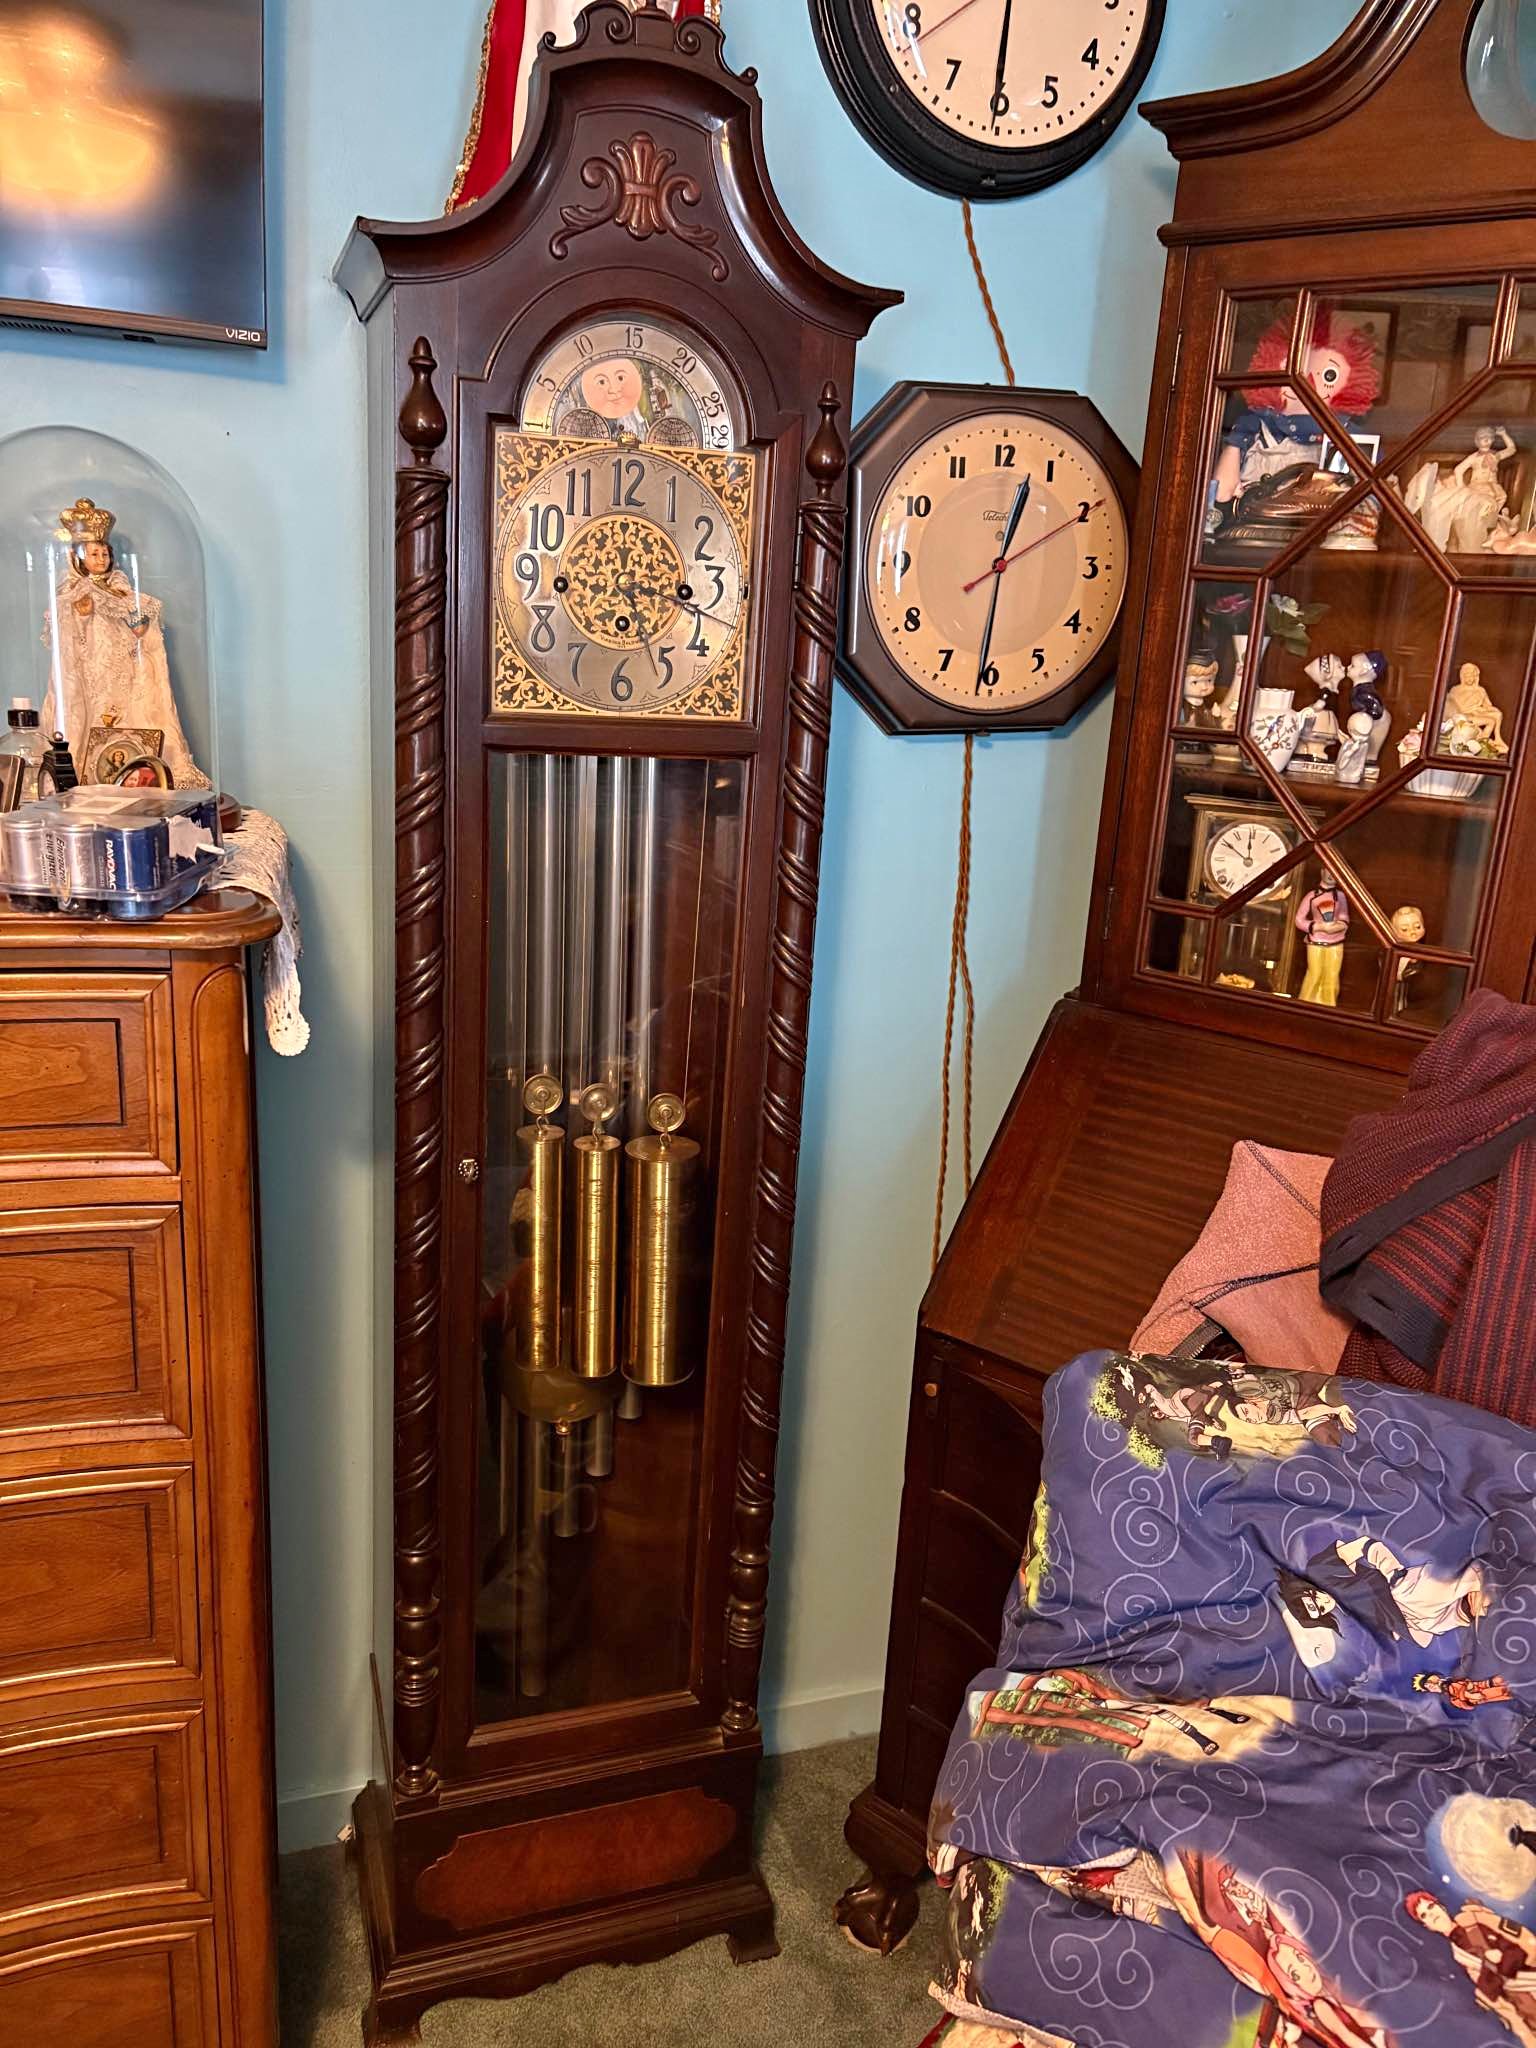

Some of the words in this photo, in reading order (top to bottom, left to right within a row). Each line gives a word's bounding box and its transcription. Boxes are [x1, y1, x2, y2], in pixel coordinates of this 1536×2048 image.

[904, 3, 921, 38] 8
[1081, 38, 1100, 70] 4
[946, 59, 962, 90] 7
[990, 82, 1010, 117] 6
[1041, 76, 1058, 108] 5
[225, 328, 261, 342] VIZIO
[573, 334, 594, 357] 10
[625, 326, 644, 349] 15
[671, 346, 697, 375] 20
[536, 373, 556, 393] 5
[702, 391, 725, 418] 25
[524, 421, 544, 429] 1
[710, 424, 729, 449] 29
[994, 444, 1016, 467] 12
[611, 458, 646, 507] 12
[1046, 460, 1055, 482] 1
[565, 468, 592, 517] 11
[666, 476, 676, 523] 1
[905, 495, 931, 517] 10
[528, 503, 565, 551] 10
[1078, 502, 1091, 523] 2
[694, 515, 715, 561] 2
[515, 552, 540, 601] 9
[893, 550, 911, 577] 9
[1082, 556, 1099, 579] 3
[704, 564, 726, 611] 3
[530, 604, 556, 653] 8
[686, 610, 710, 657] 4
[904, 607, 921, 632] 8
[1063, 609, 1082, 634] 4
[567, 642, 588, 687] 7
[657, 645, 676, 690] 5
[938, 649, 954, 672] 7
[982, 661, 999, 686] 6
[1031, 648, 1045, 673] 5
[610, 657, 633, 702] 6
[105, 839, 117, 891] RAYOVAC
